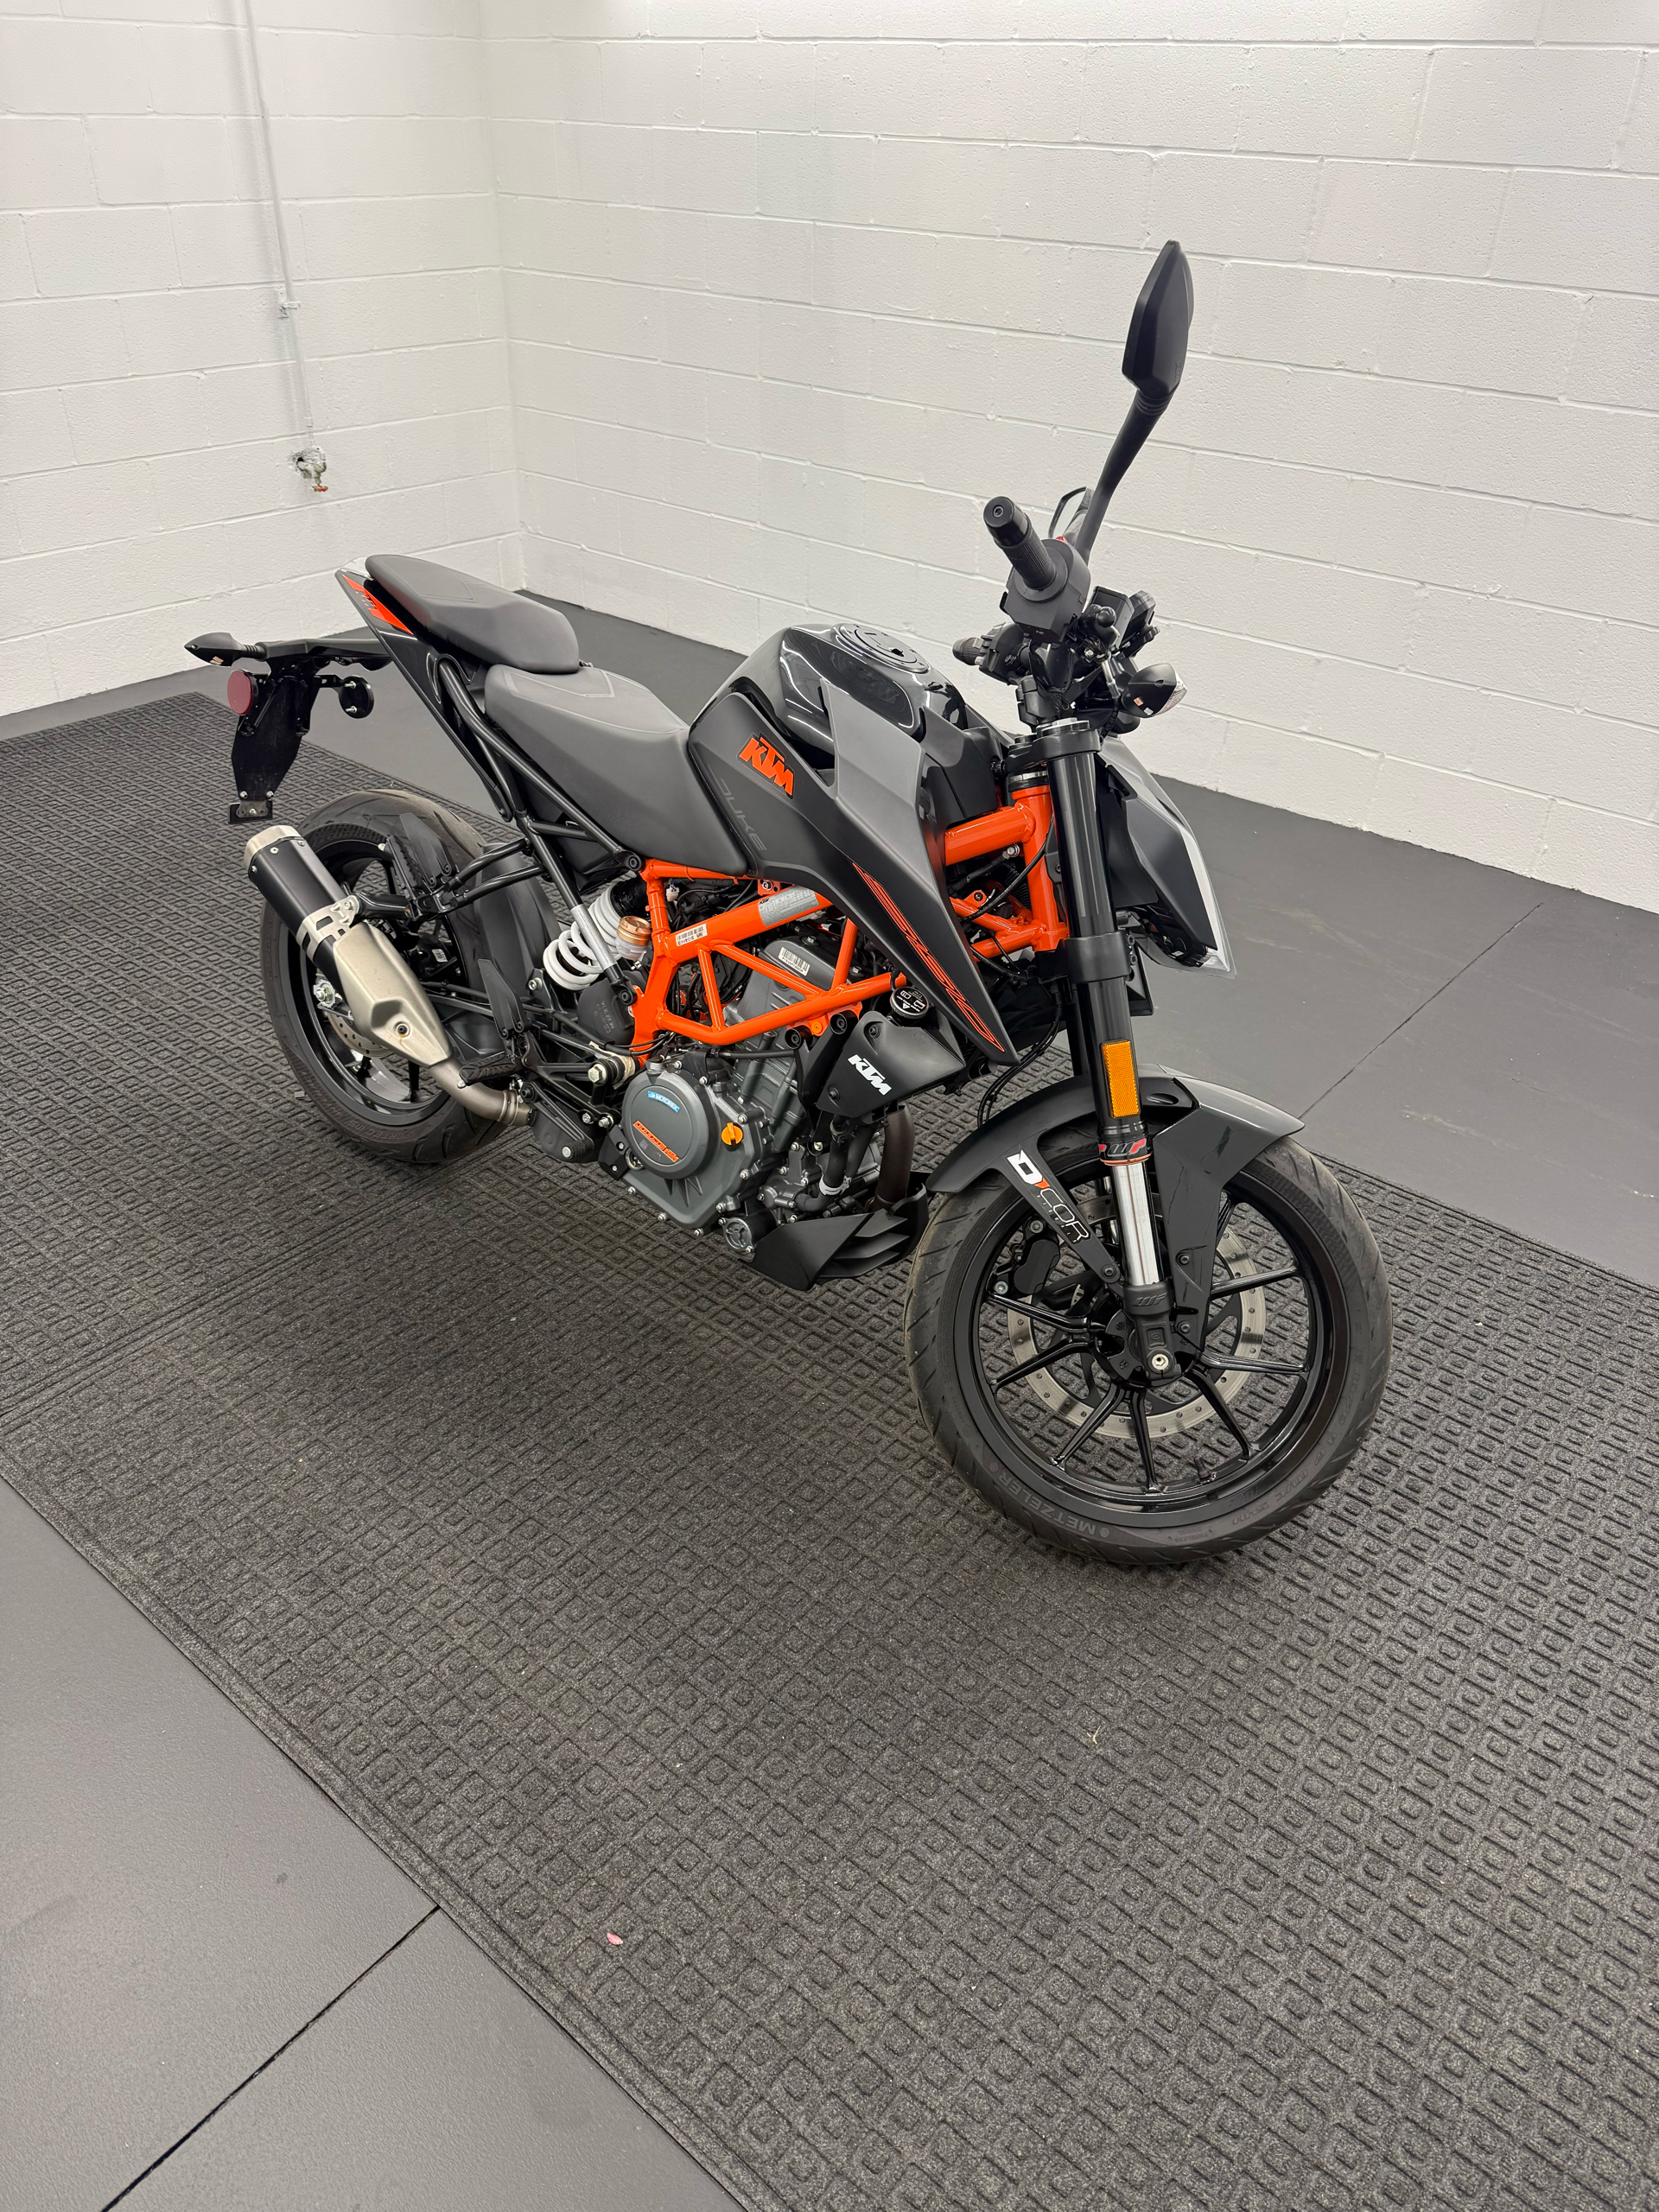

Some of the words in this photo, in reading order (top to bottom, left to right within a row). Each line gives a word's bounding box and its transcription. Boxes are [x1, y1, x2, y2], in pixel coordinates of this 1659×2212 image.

[739, 736, 794, 797] KTM
[708, 763, 767, 851] DUKE
[847, 1054, 893, 1096] KTM
[655, 1092, 681, 1113] MOTOREX
[1107, 1137, 1147, 1157] WP
[998, 1470, 1096, 1536] METZELER
